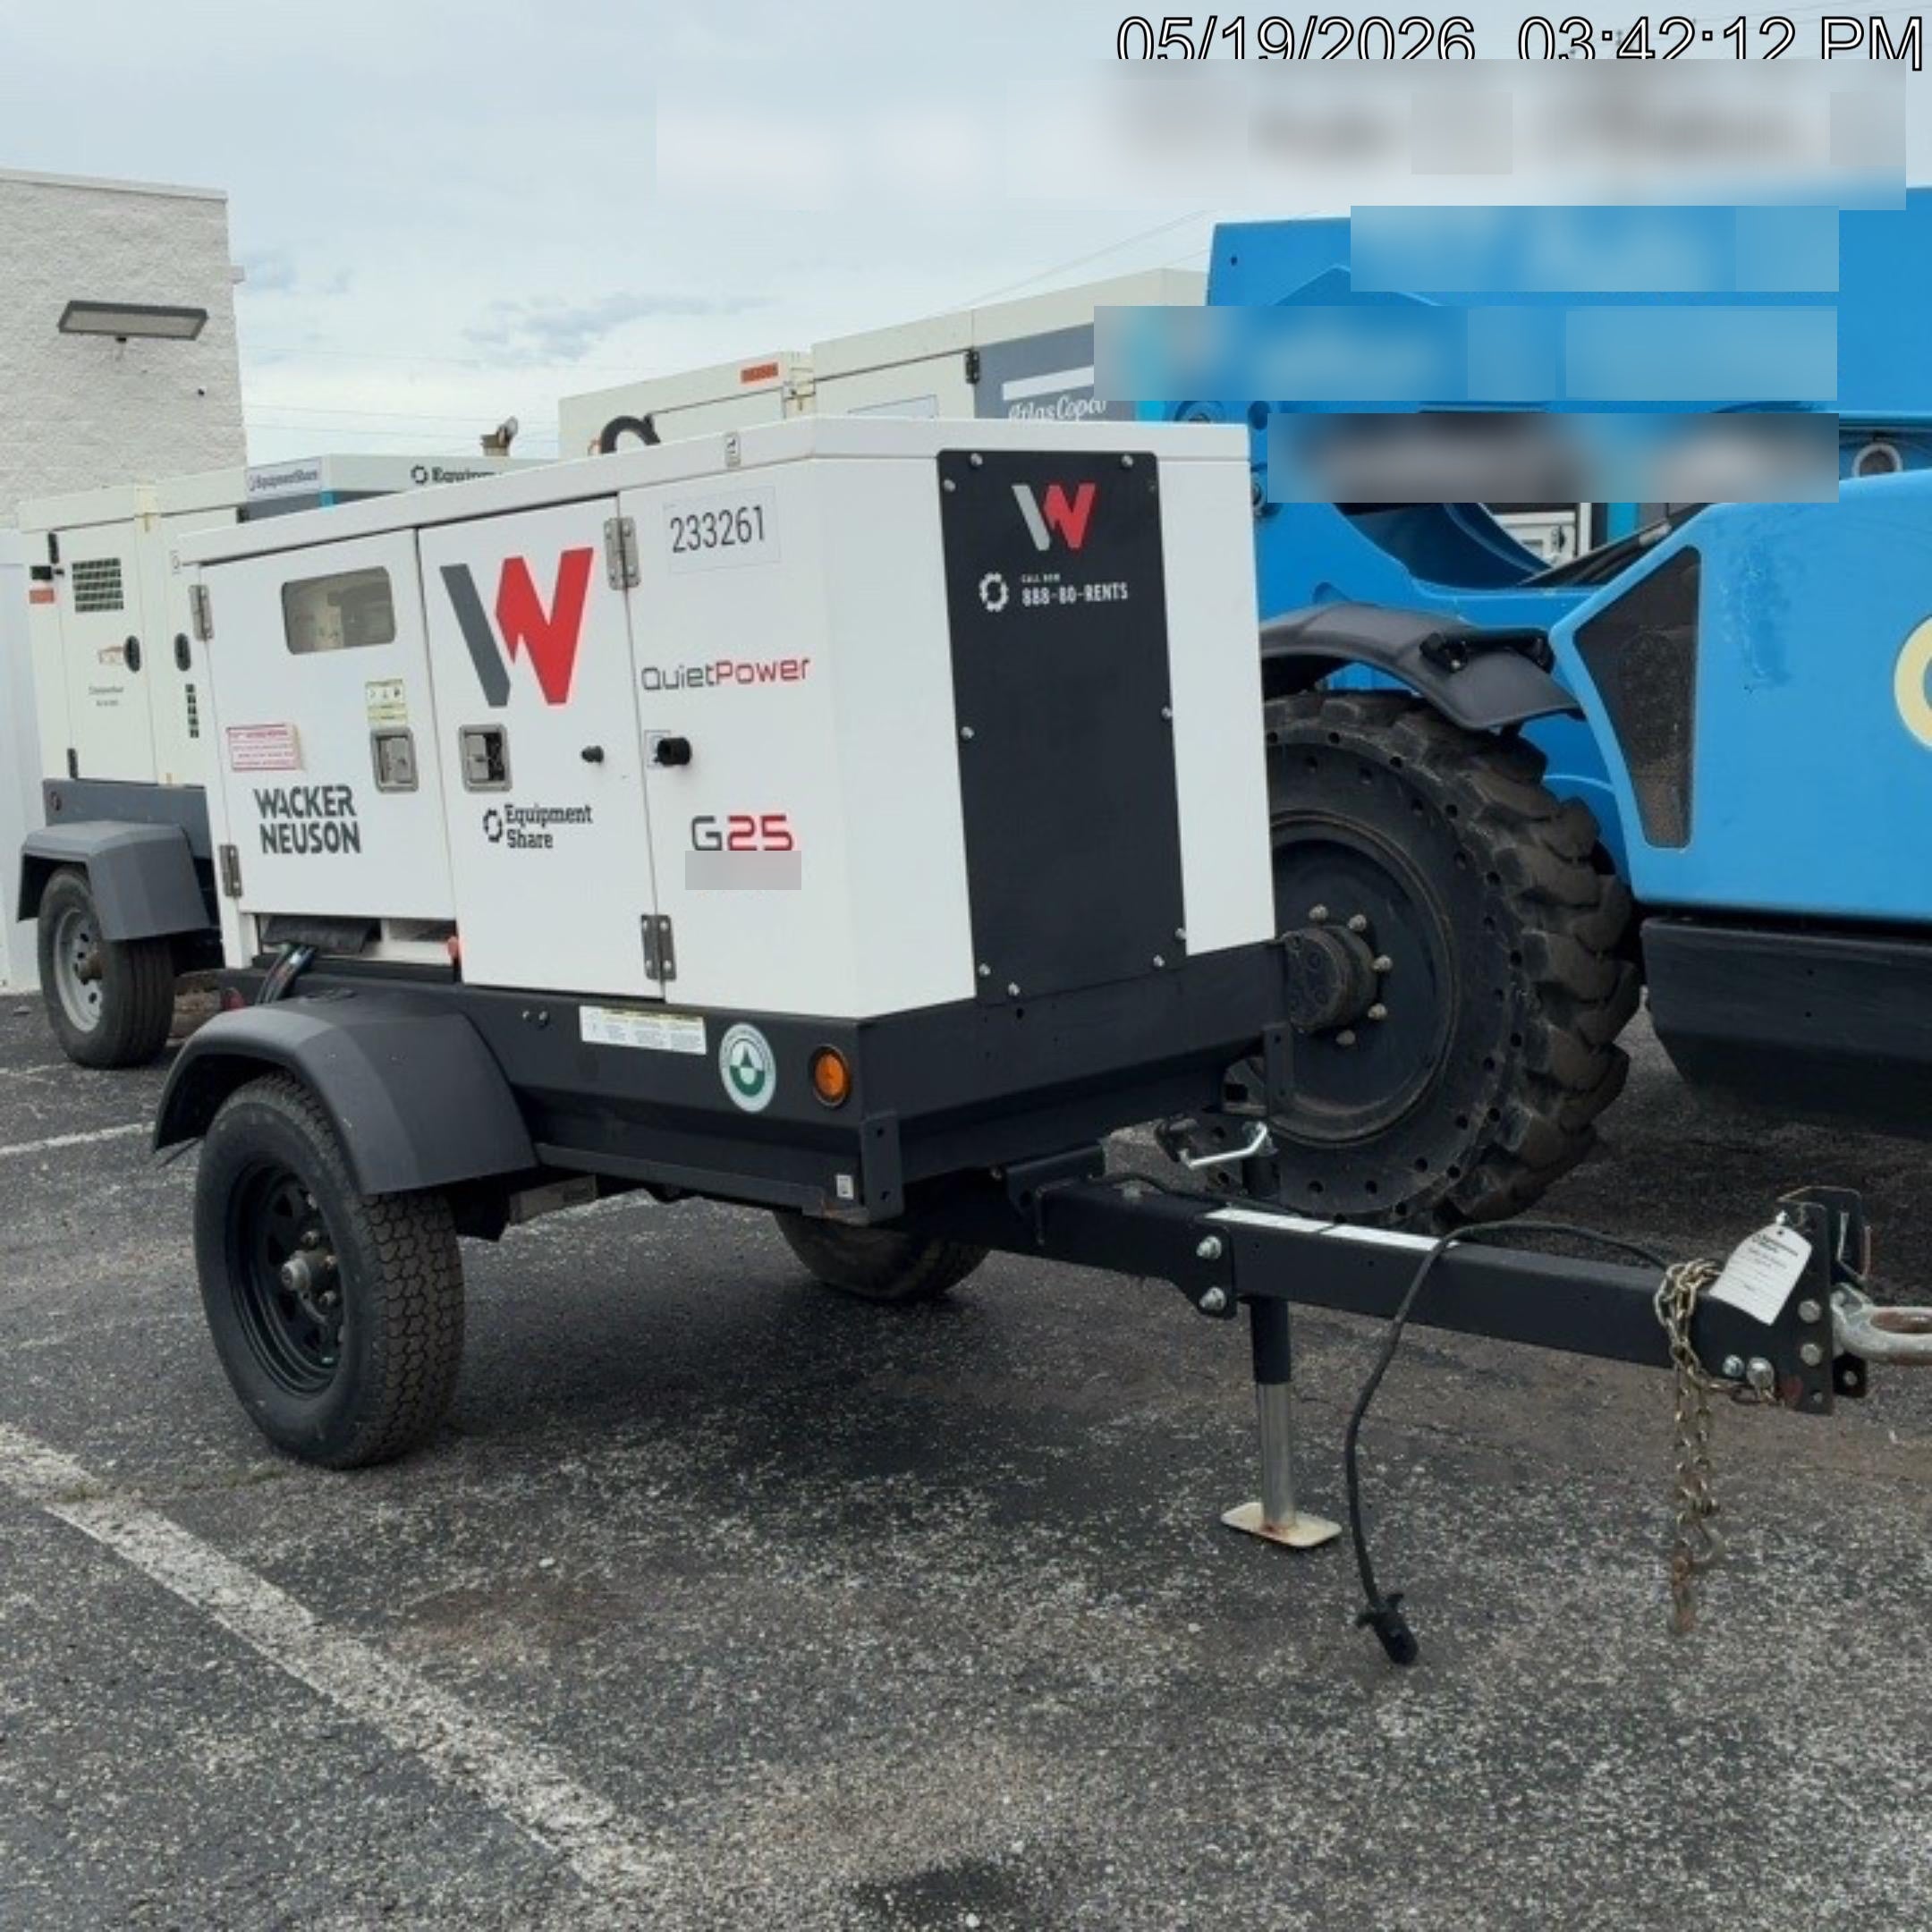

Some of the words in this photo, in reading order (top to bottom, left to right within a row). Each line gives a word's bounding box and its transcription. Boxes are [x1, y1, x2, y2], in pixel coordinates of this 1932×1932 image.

[670, 504, 765, 553] 233261
[1021, 581, 1128, 606] 888-80-RENTS
[641, 657, 810, 691] QuietPower
[253, 784, 357, 818] WACKER
[504, 804, 593, 828] Equipment
[259, 820, 361, 854] NEUSON
[506, 828, 554, 849] Share
[691, 815, 793, 851] G25
